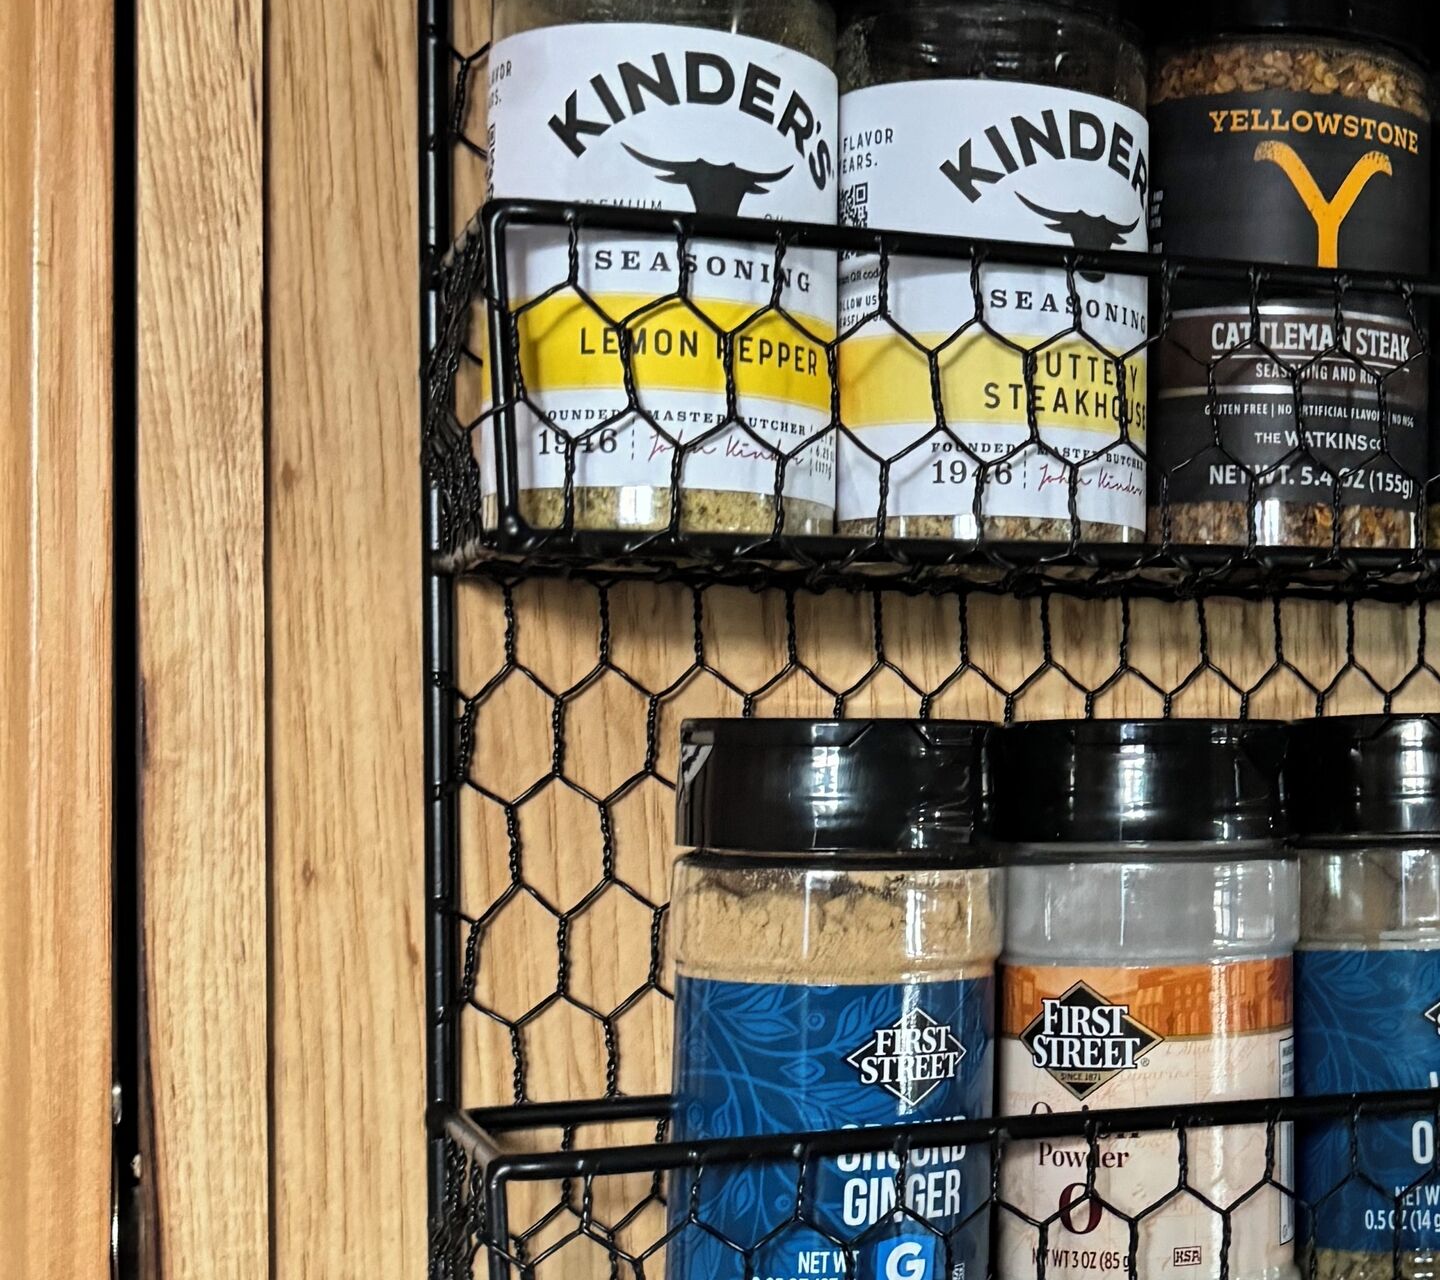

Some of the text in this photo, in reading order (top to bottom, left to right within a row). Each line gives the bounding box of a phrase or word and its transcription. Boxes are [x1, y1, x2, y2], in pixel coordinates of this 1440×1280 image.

[547, 50, 834, 192] KINDER'S
[1209, 108, 1420, 155] YELLOWSTONE
[843, 127, 894, 153] FLAVOR
[594, 249, 812, 293] SEASONING
[850, 269, 863, 282] QR
[865, 294, 878, 307] US
[579, 327, 699, 359] LEMON
[1356, 326, 1411, 363] STEAK
[1332, 365, 1356, 383] AND
[1244, 403, 1293, 415] FREE NO
[538, 427, 618, 456] 1946
[1254, 431, 1367, 452] THE WATKINS
[1209, 465, 1414, 500] NET WT. 5.4 (155g)
[1042, 998, 1130, 1038] FIRST
[874, 1025, 951, 1057] FIRST
[1032, 1034, 1141, 1070] STREET
[860, 1051, 959, 1085] STREET
[1060, 1071, 1102, 1082] SINCE 1871
[842, 1168, 962, 1227] GINGER
[1058, 1182, 1103, 1235] O
[1364, 1210, 1386, 1230] 0.5
[798, 1250, 832, 1276] NET
[1051, 1249, 1098, 1271] WT 3 OZ
